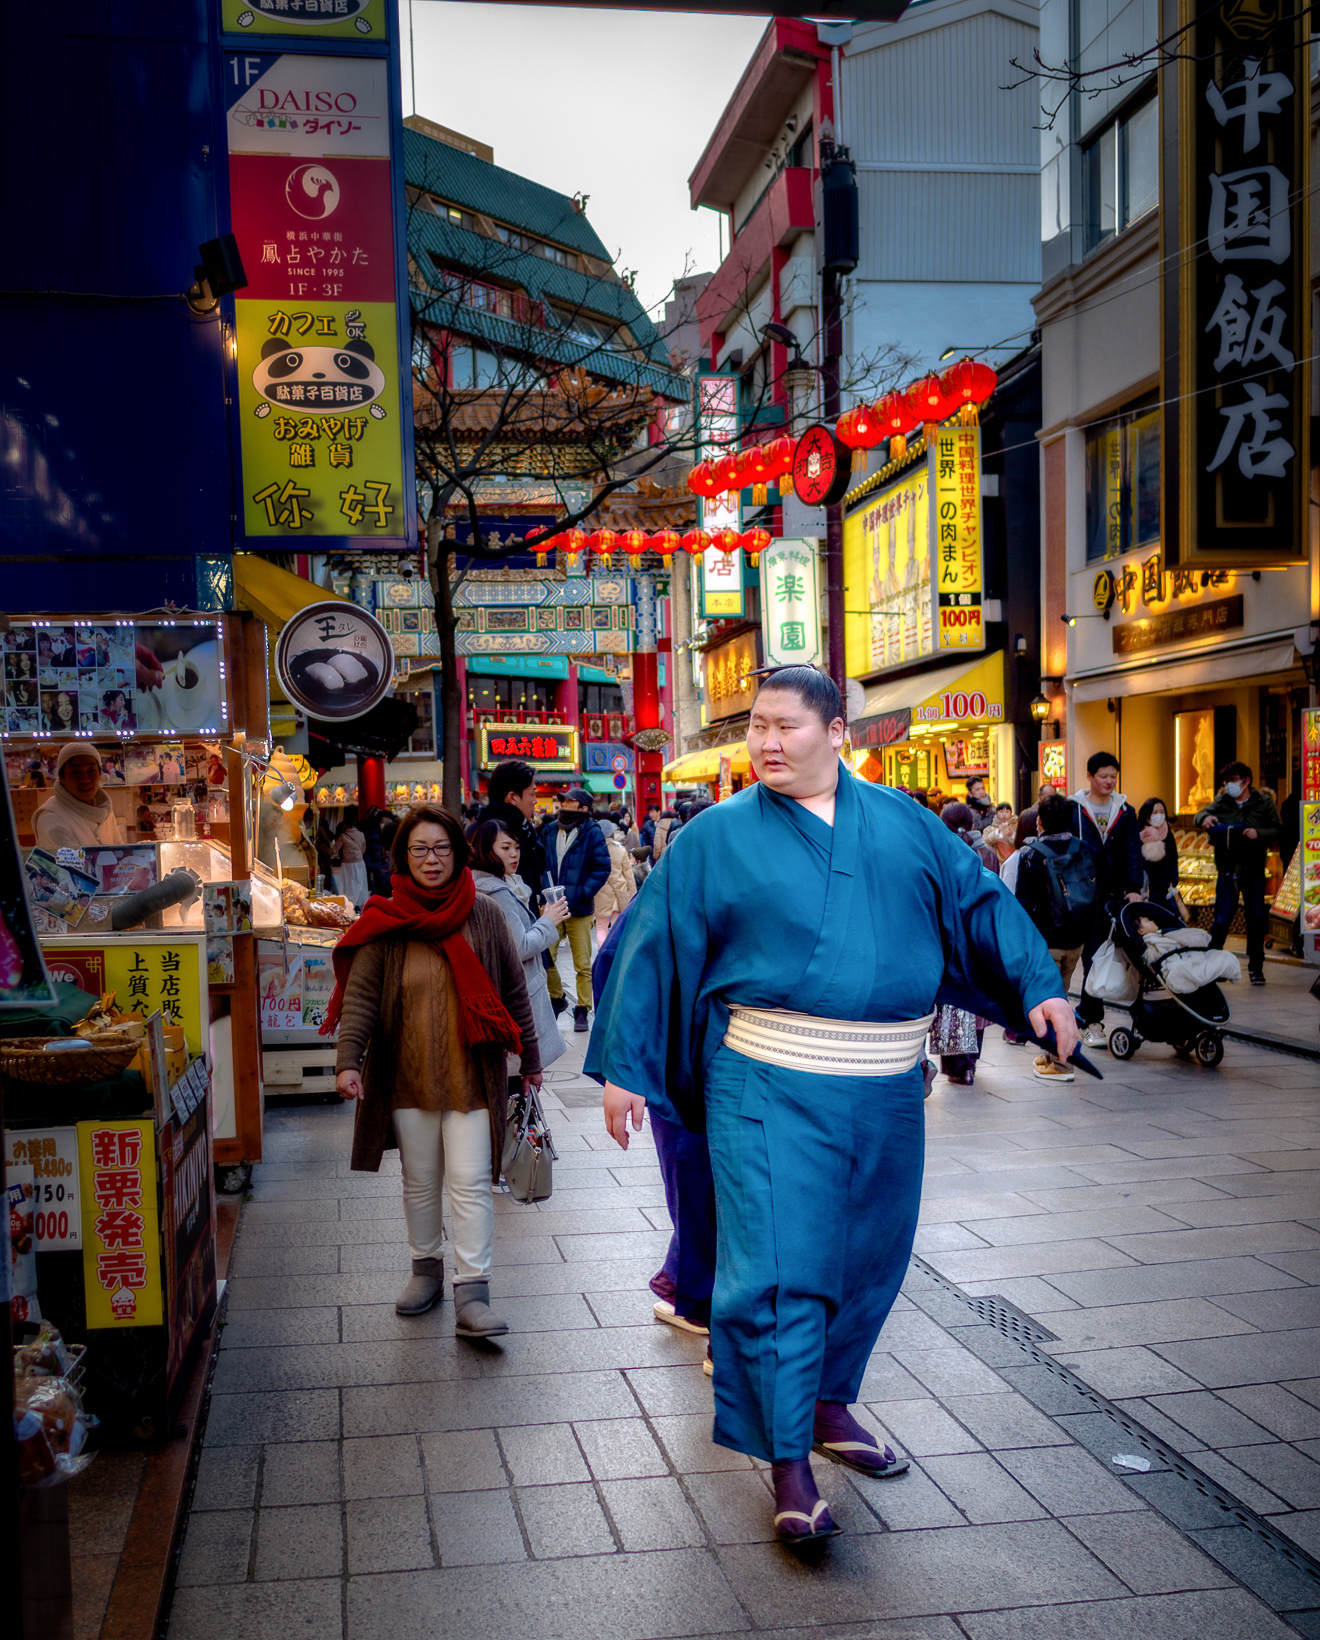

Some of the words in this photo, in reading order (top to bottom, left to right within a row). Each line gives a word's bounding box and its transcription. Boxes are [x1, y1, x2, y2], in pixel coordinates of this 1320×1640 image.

[229, 57, 260, 86] 1F
[257, 89, 357, 113] DAISO
[303, 118, 361, 135] ダイソー
[286, 230, 343, 242] 横浜中華街
[287, 267, 316, 276] SINCE
[322, 269, 344, 277] 1995
[1206, 55, 1296, 480] 中国飯店
[268, 310, 337, 337] カフェ
[346, 327, 364, 338] OK
[276, 385, 363, 401] 駄菓子百貨店
[273, 416, 368, 441] おみやげ
[289, 443, 354, 468] 雑貨
[252, 479, 394, 529] 你好
[862, 478, 929, 538] 中国料理世界チャン
[939, 438, 958, 584] 世界一の肉まん
[774, 573, 806, 651] 楽園
[940, 609, 981, 627] 100円
[160, 951, 184, 1027] 当店販
[91, 1128, 148, 1291] 新栗発売
